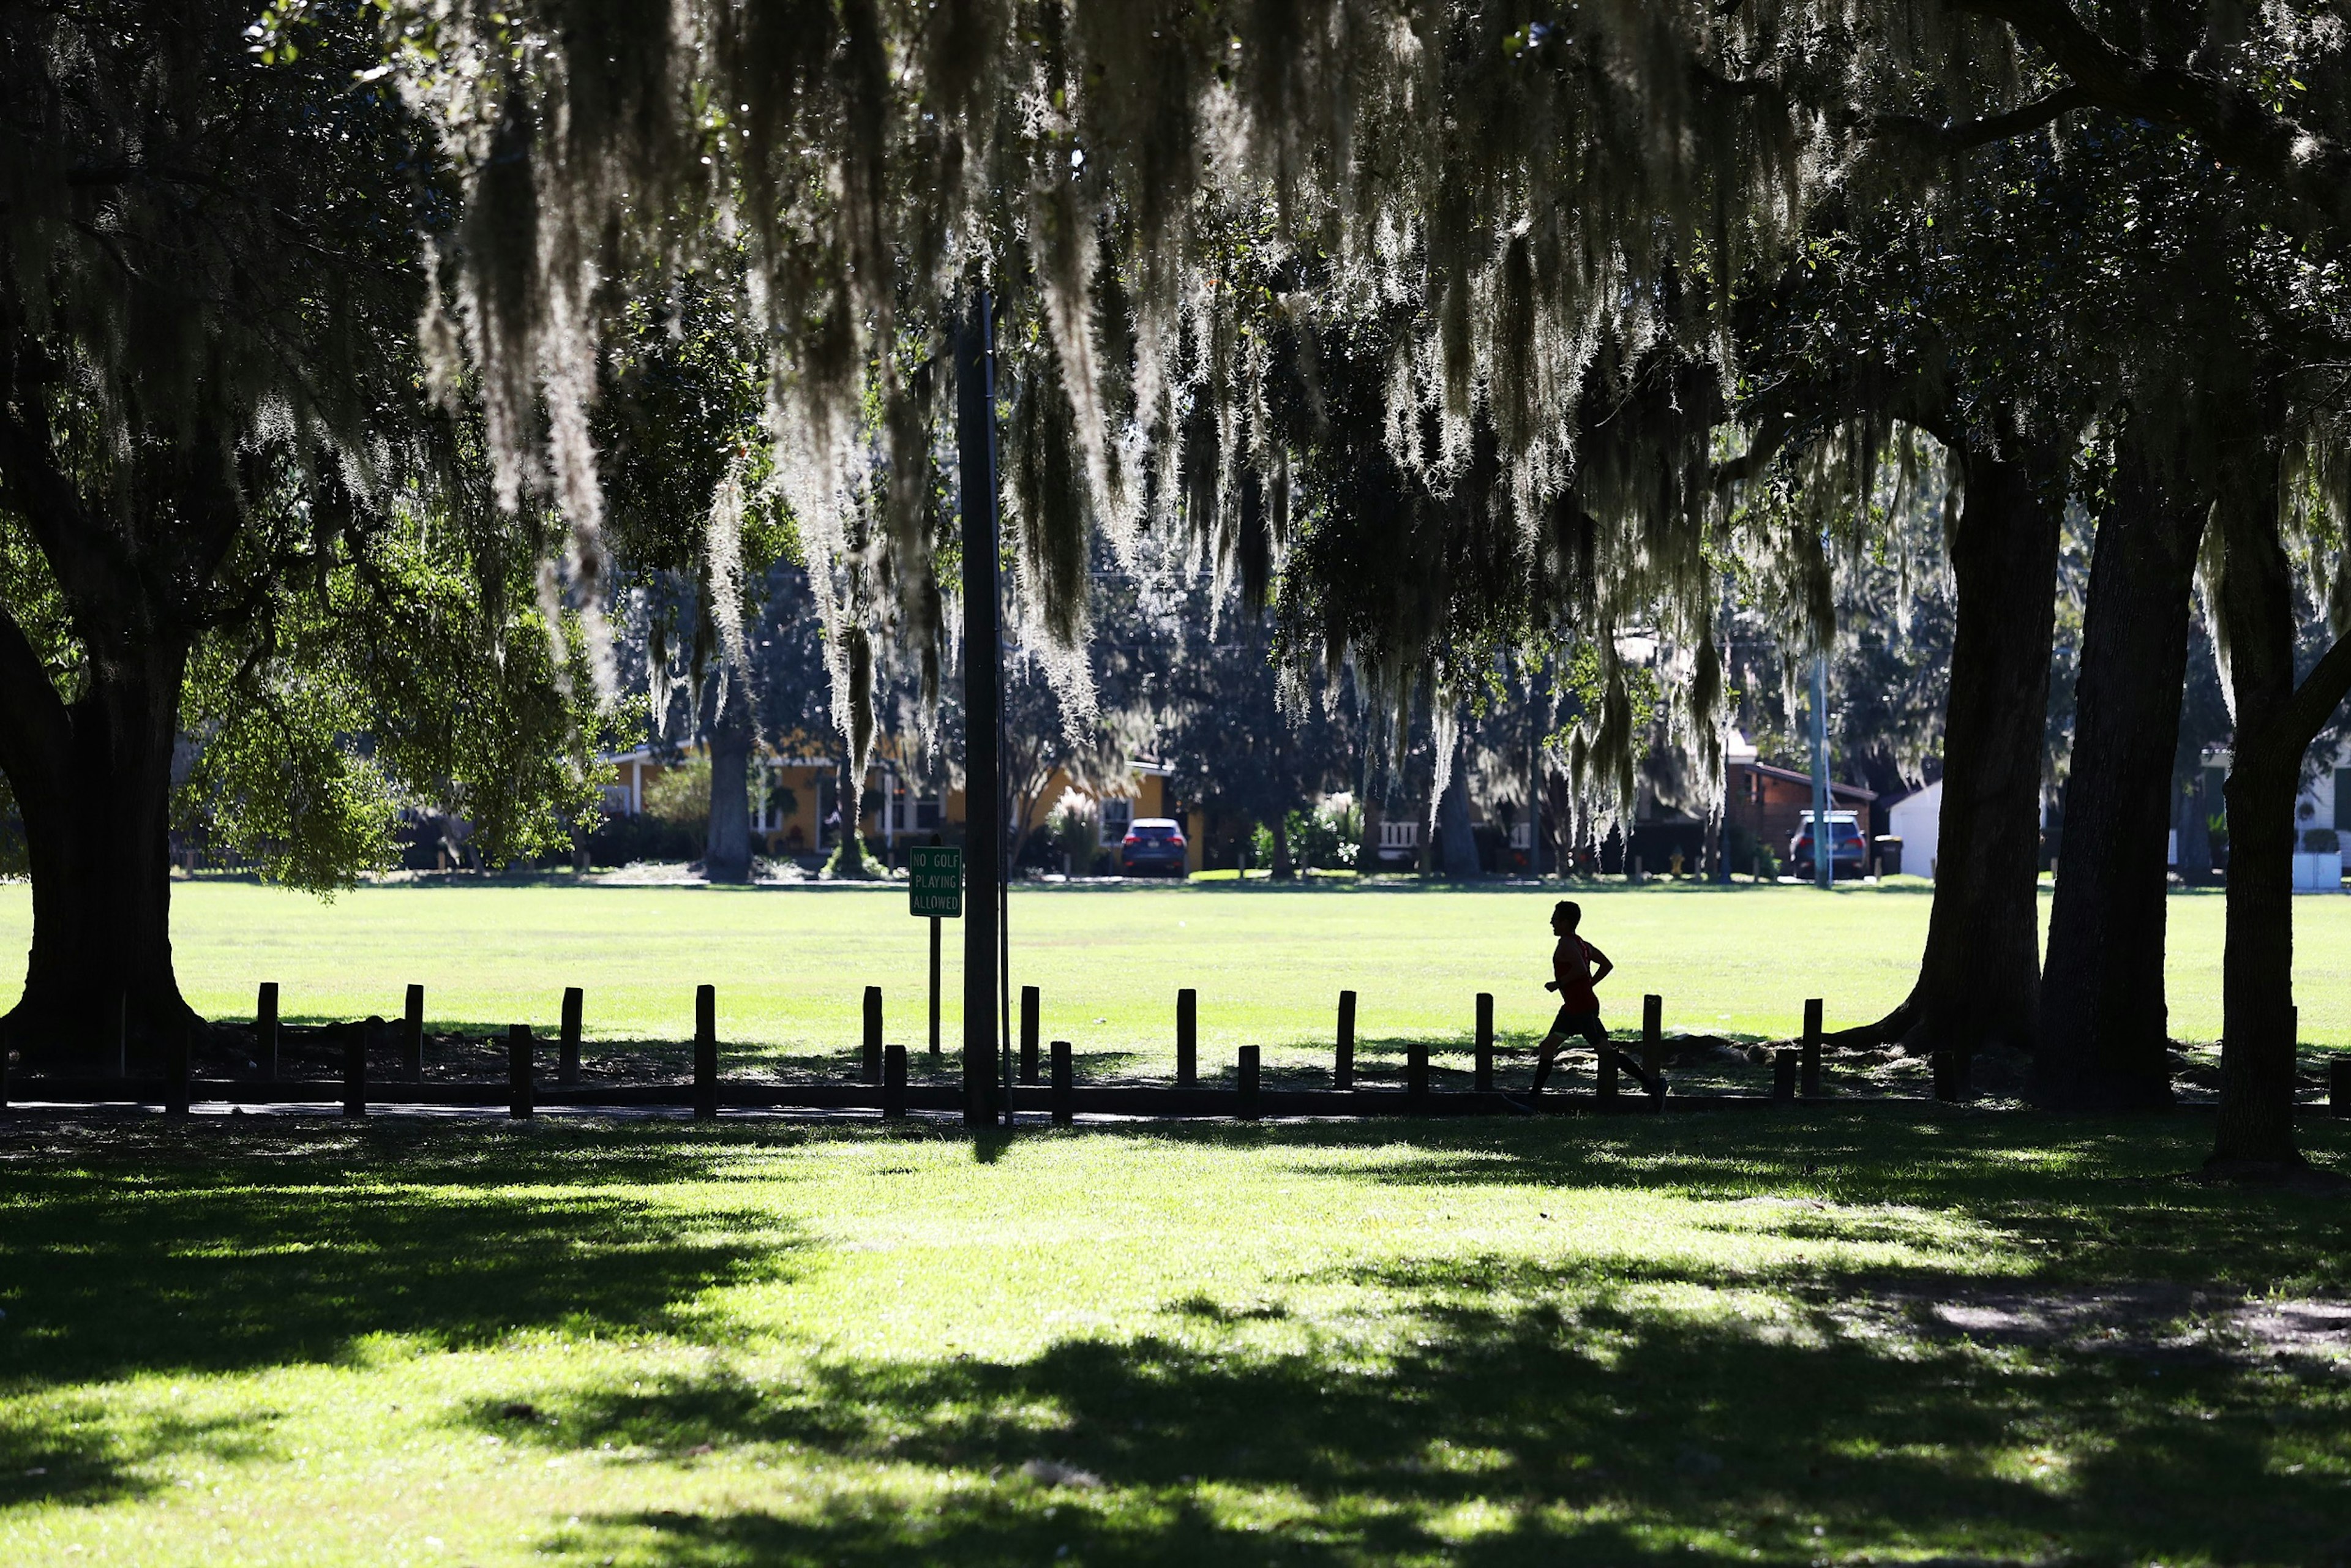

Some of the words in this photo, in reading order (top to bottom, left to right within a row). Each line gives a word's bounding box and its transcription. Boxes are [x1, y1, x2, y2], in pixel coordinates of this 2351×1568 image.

[913, 853, 926, 867] NO
[934, 854, 959, 868] GOLF
[915, 875, 956, 888] PLAYING
[913, 895, 958, 909] ALLOWED
